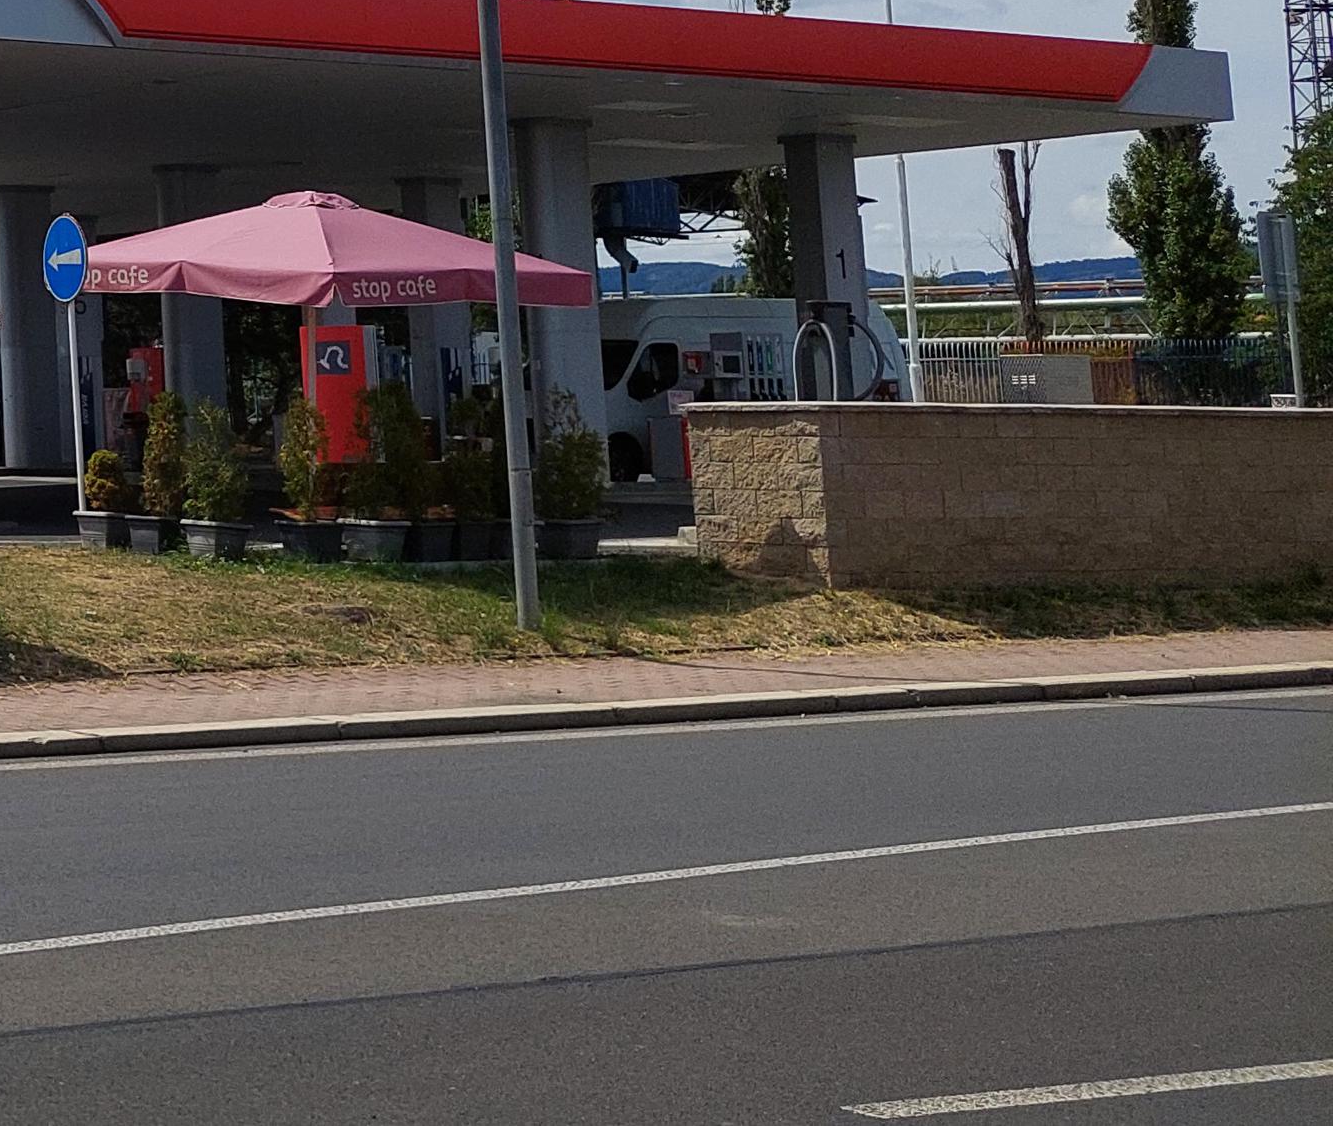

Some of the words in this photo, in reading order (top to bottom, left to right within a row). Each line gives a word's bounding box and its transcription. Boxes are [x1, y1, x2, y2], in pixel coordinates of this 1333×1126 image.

[108, 265, 150, 287] cafe
[353, 278, 390, 302] stop
[396, 275, 438, 299] cafe
